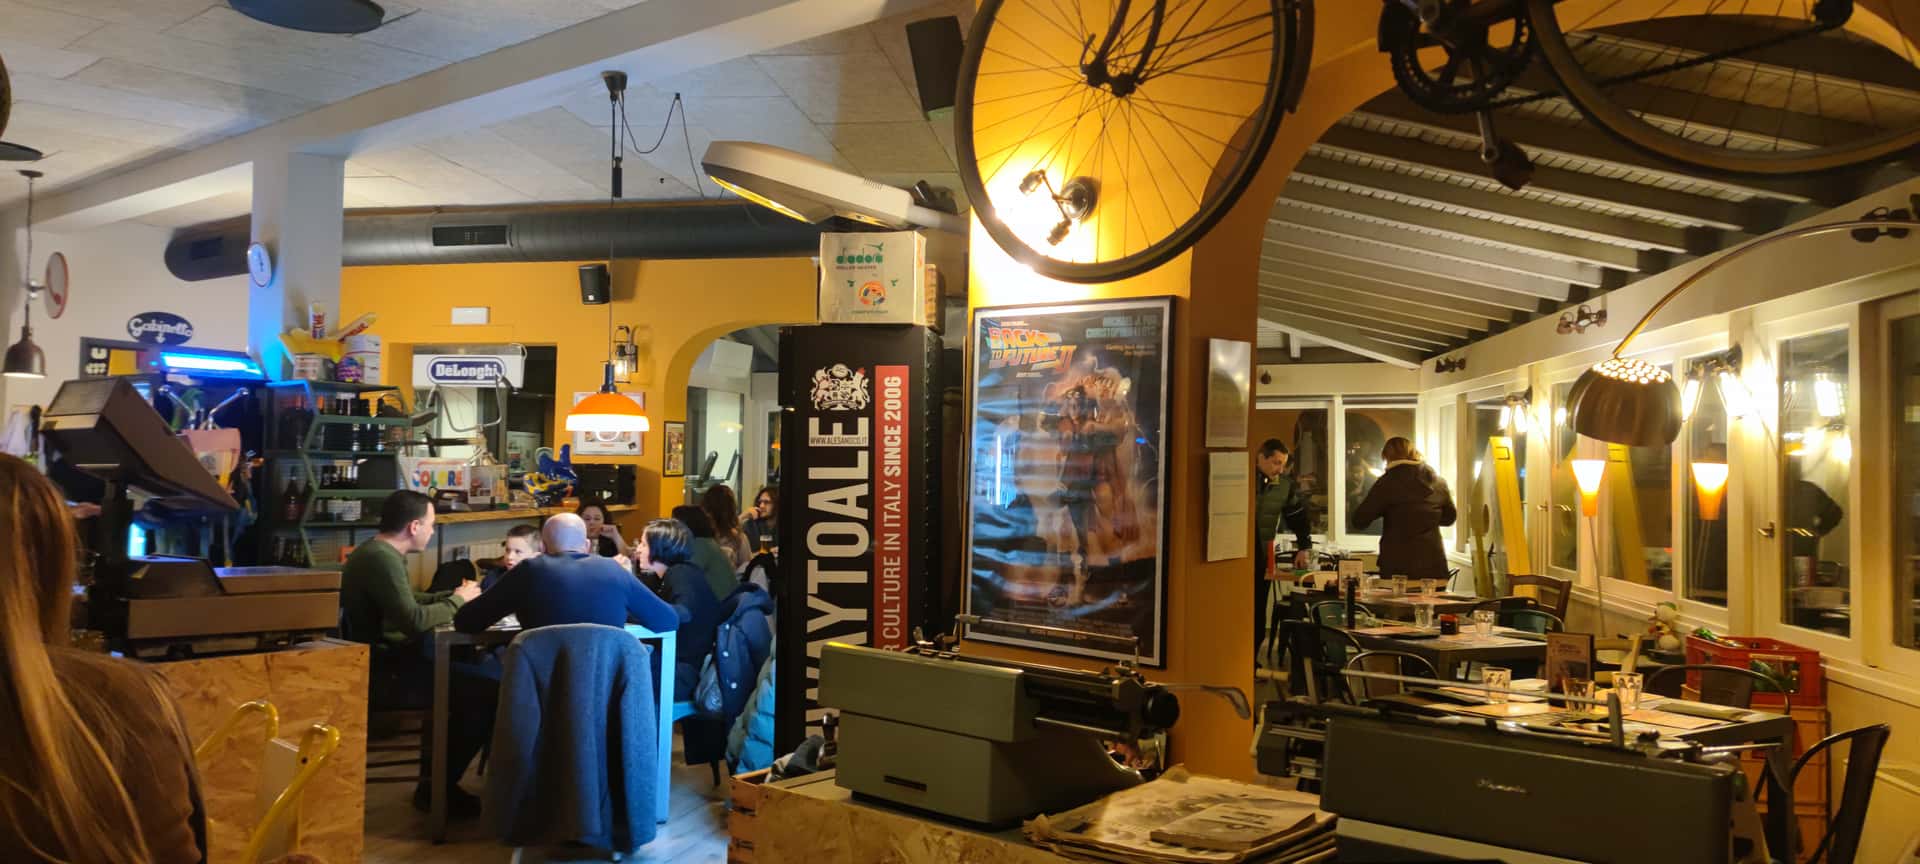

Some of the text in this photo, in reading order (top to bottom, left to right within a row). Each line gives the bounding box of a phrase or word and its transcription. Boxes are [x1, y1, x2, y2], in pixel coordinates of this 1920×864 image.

[883, 376, 902, 421] 2006
[883, 425, 902, 477] SINCE
[883, 481, 901, 527] ITALY
[883, 533, 901, 551] IN
[883, 556, 901, 639] CULTURE
